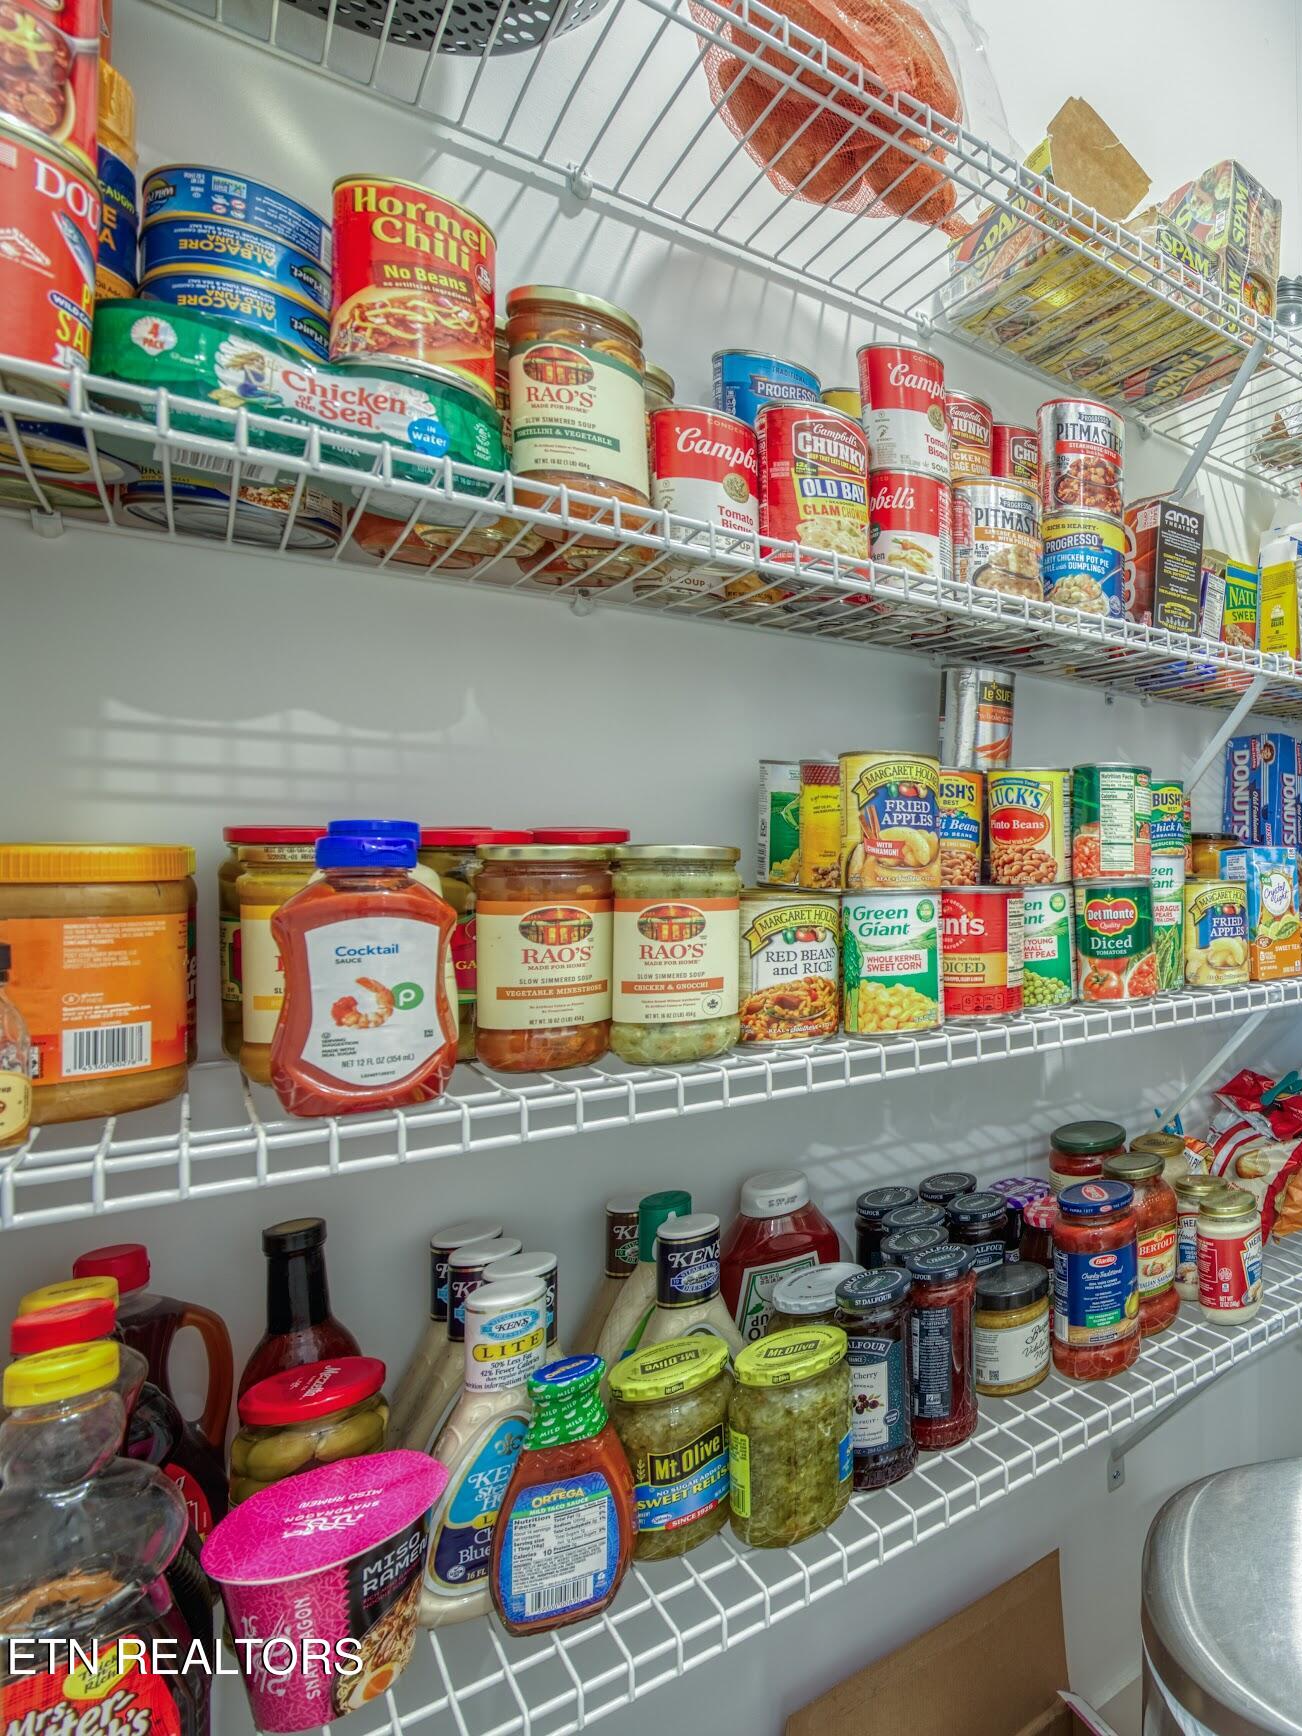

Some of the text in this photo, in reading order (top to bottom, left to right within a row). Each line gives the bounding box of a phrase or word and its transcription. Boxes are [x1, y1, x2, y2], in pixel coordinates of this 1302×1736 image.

[354, 187, 488, 256] Hormel
[1232, 182, 1250, 247] SPAM
[179, 238, 276, 265] ALBACORE
[372, 216, 470, 272] Chili
[384, 265, 467, 293] No Beans
[177, 294, 276, 320] ALBACORE
[148, 320, 160, 337] 4
[142, 337, 167, 350] PACK
[281, 370, 407, 417] Chicken
[526, 386, 593, 408] RAO'S
[756, 381, 816, 405] PROGRESSO
[812, 423, 857, 447] Campbell's
[798, 432, 865, 469] CHUNKY
[802, 479, 864, 503] OLD BAY
[1004, 502, 1032, 511] PROGRESSO
[717, 505, 754, 526] Tomato
[1165, 520, 1199, 535] THEATRES
[1045, 535, 1098, 552] PROGRESSO
[990, 785, 1043, 809] LUCK'S
[1233, 750, 1250, 839] DONUTS
[885, 800, 931, 813] FRIED
[1283, 773, 1296, 844] DONUTS
[882, 813, 933, 827] APPLES
[951, 819, 978, 832] Beans
[991, 820, 1044, 829] Pinto Beans
[876, 841, 893, 849] WITH
[1263, 883, 1286, 899] Crystal
[853, 906, 908, 921] Green
[1088, 910, 1135, 920] Del Monte
[858, 922, 911, 937] Giant
[1099, 922, 1121, 930] Quality
[1213, 917, 1243, 927] FRIED
[1210, 926, 1245, 937] APPLES
[1091, 935, 1132, 950] Diced
[335, 944, 399, 957] Cocktail
[520, 947, 592, 965] RAO'S
[638, 944, 704, 960] RAO'S
[765, 949, 836, 963] RED BEANS
[1036, 950, 1056, 958] PEAS
[867, 953, 922, 964] WHOLE KERNEL
[773, 960, 833, 975] and RICE
[867, 961, 922, 973] SWEET CORN
[519, 977, 538, 986] SLOW
[540, 976, 576, 984] SIMMERED
[634, 981, 709, 992] CHICKEN & GNOCCHI
[505, 984, 603, 998] VEGETABLE MINESTRONE
[1139, 1235, 1175, 1256] BERTOLLI
[1094, 1256, 1117, 1266] Barilla
[482, 1333, 541, 1359] LITE
[507, 1357, 521, 1367] Less
[522, 1353, 532, 1363] Fat
[495, 1366, 514, 1376] Fewer
[853, 1371, 877, 1380] Cherry
[655, 1435, 721, 1481] Mt. Olive
[532, 1492, 584, 1508] ORTEGA
[566, 1497, 588, 1508] SAUCE
[671, 1503, 713, 1527] SINCE 1926
[362, 1531, 420, 1581] MISO
